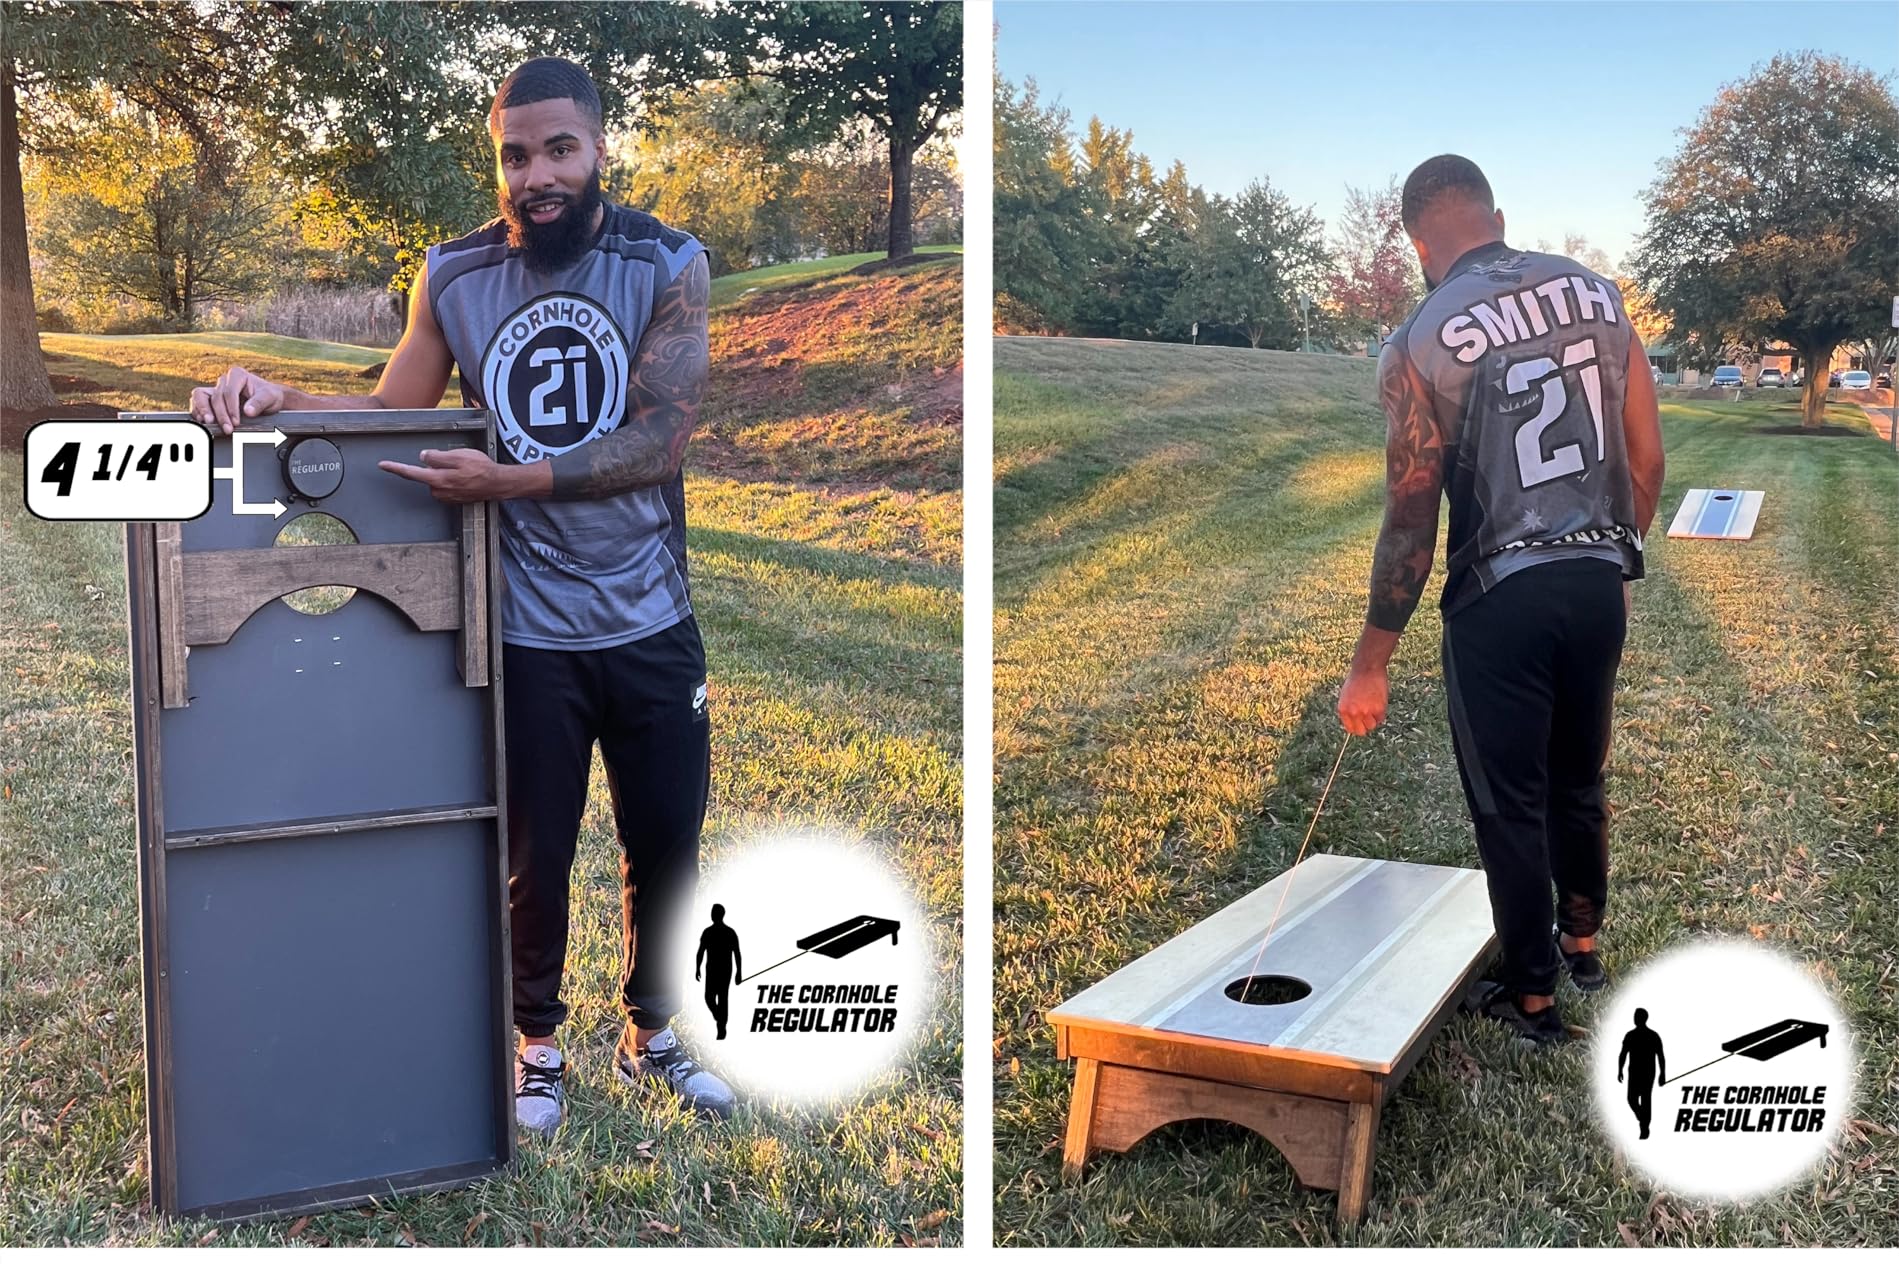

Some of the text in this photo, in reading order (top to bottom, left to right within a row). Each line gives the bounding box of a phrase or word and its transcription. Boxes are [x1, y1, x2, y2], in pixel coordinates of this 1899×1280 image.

[498, 302, 616, 359] CORNHOLE
[1441, 275, 1617, 364] SMITH
[529, 345, 590, 427] 21
[1506, 338, 1605, 489] 21
[292, 462, 341, 475] REGULATOR
